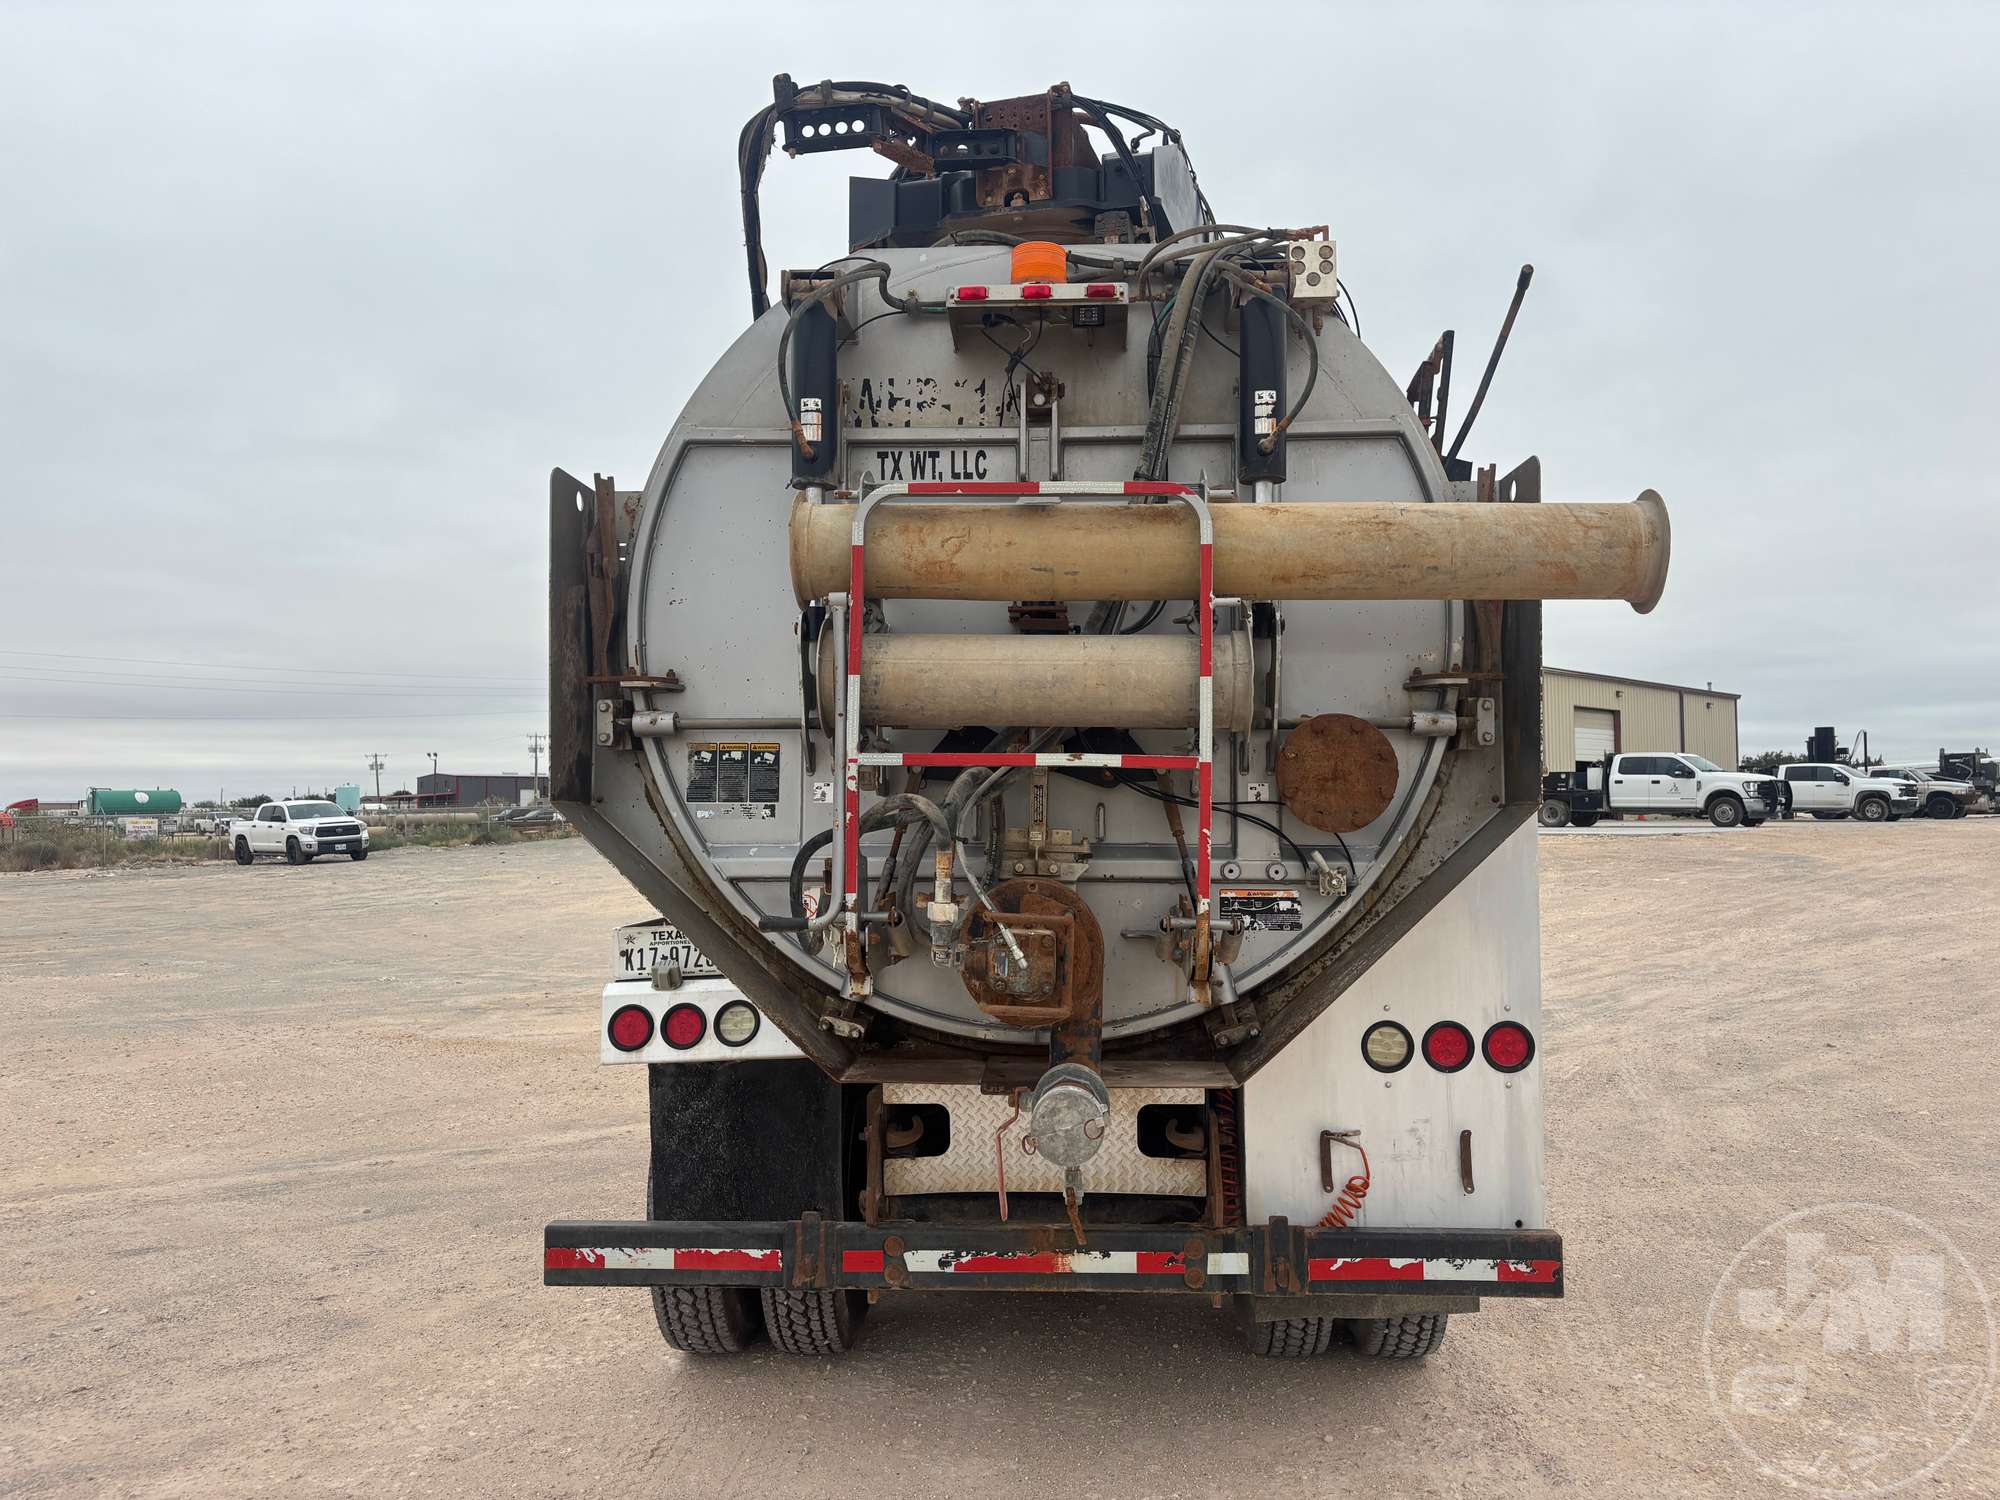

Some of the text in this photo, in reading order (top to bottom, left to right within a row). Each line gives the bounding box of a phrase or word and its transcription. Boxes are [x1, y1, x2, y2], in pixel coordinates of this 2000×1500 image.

[876, 449, 988, 482] TX WT, LLC
